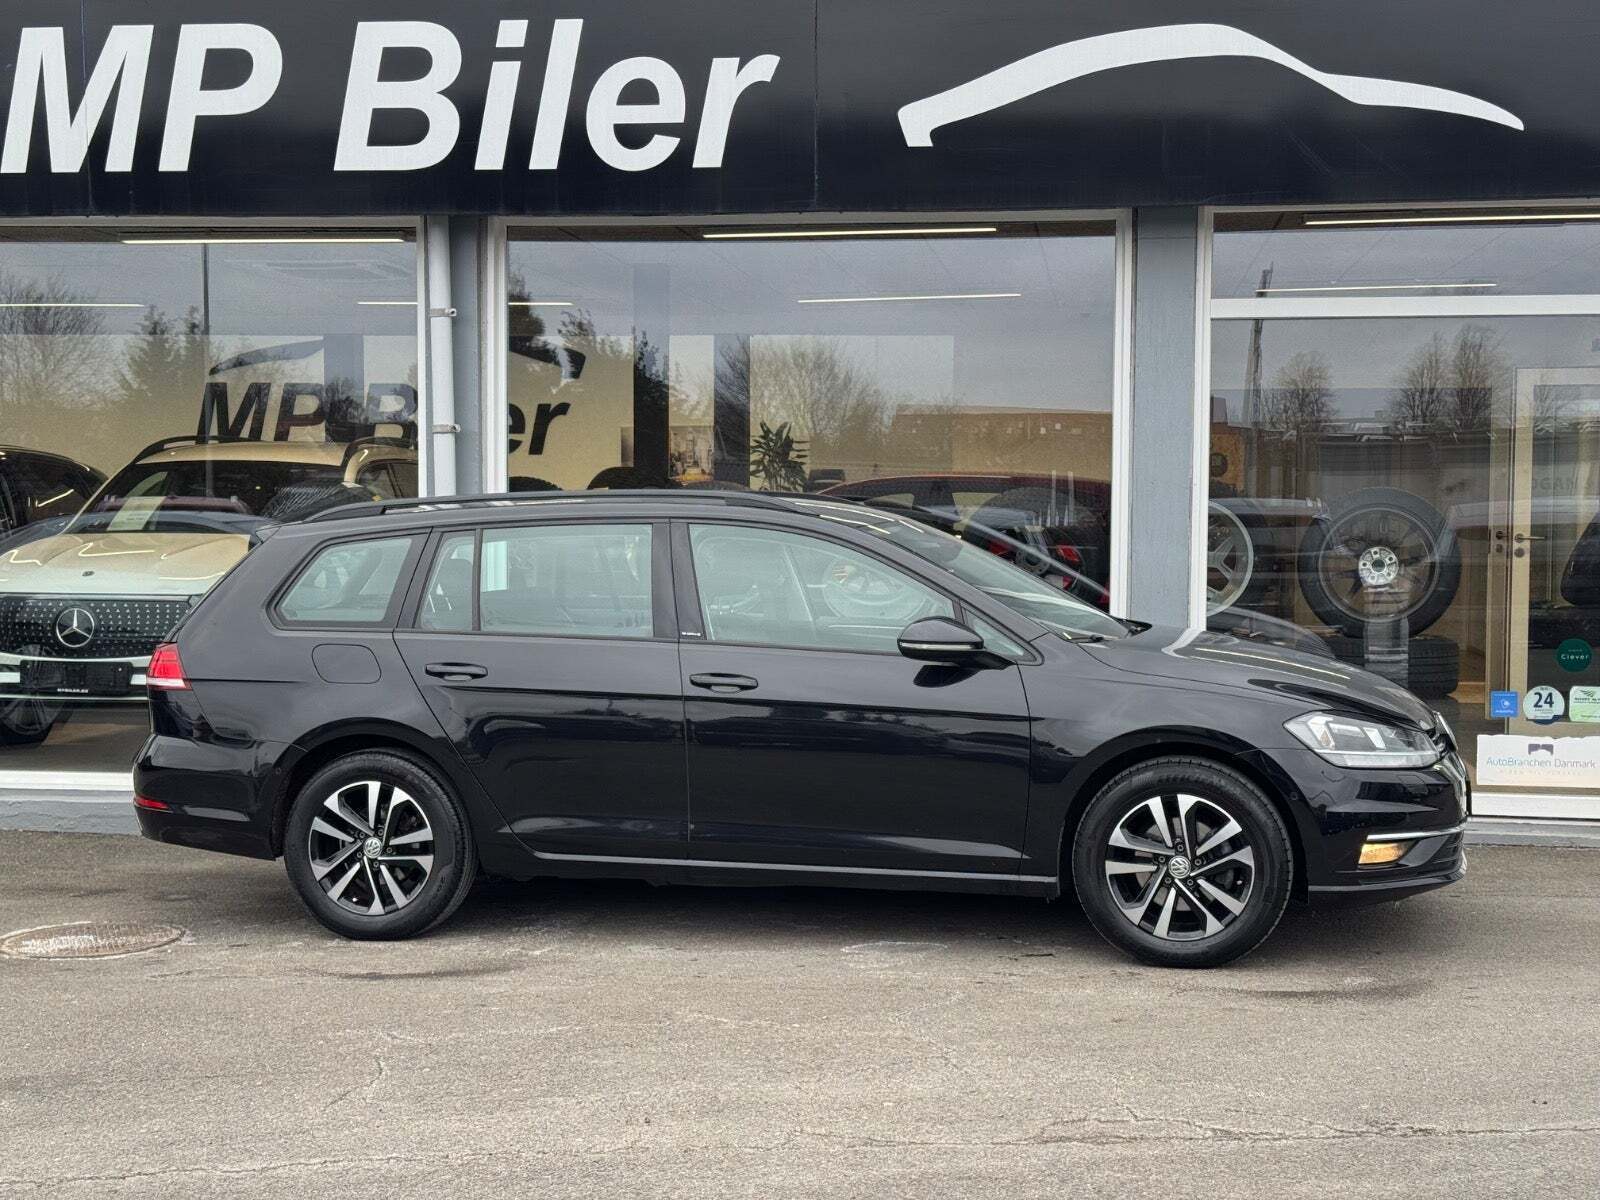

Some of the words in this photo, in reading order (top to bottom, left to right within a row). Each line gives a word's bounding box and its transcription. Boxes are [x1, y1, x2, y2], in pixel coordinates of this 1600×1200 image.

[0, 24, 284, 175] MP
[333, 18, 781, 173] Biler
[195, 381, 327, 445] MP
[1533, 692, 1554, 708] 24
[1486, 757, 1552, 768] AutoBranchen
[1554, 758, 1597, 769] Danmark
